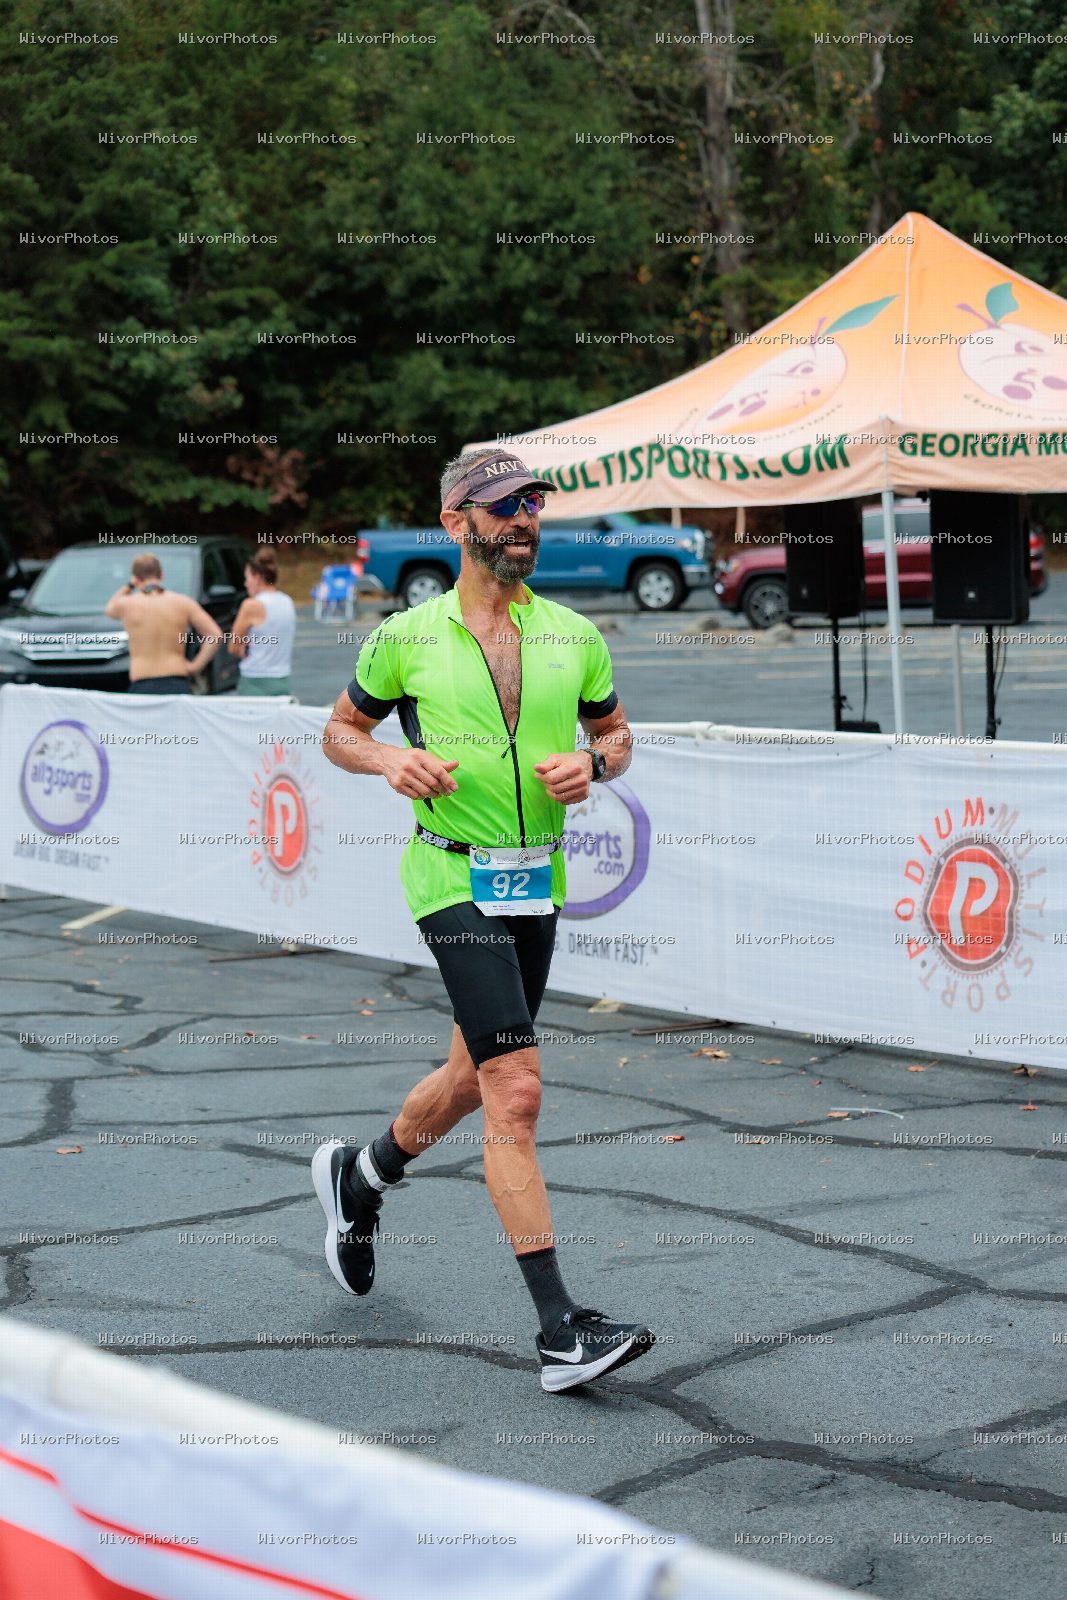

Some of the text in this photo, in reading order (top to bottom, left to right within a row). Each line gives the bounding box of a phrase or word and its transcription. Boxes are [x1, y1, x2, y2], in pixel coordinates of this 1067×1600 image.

[899, 432, 1030, 457] GEORGIA
[594, 860, 625, 876] .com
[894, 797, 986, 960] PODIUM
[492, 872, 530, 899] 92
[948, 861, 998, 948] P
[568, 932, 610, 960] DREAM
